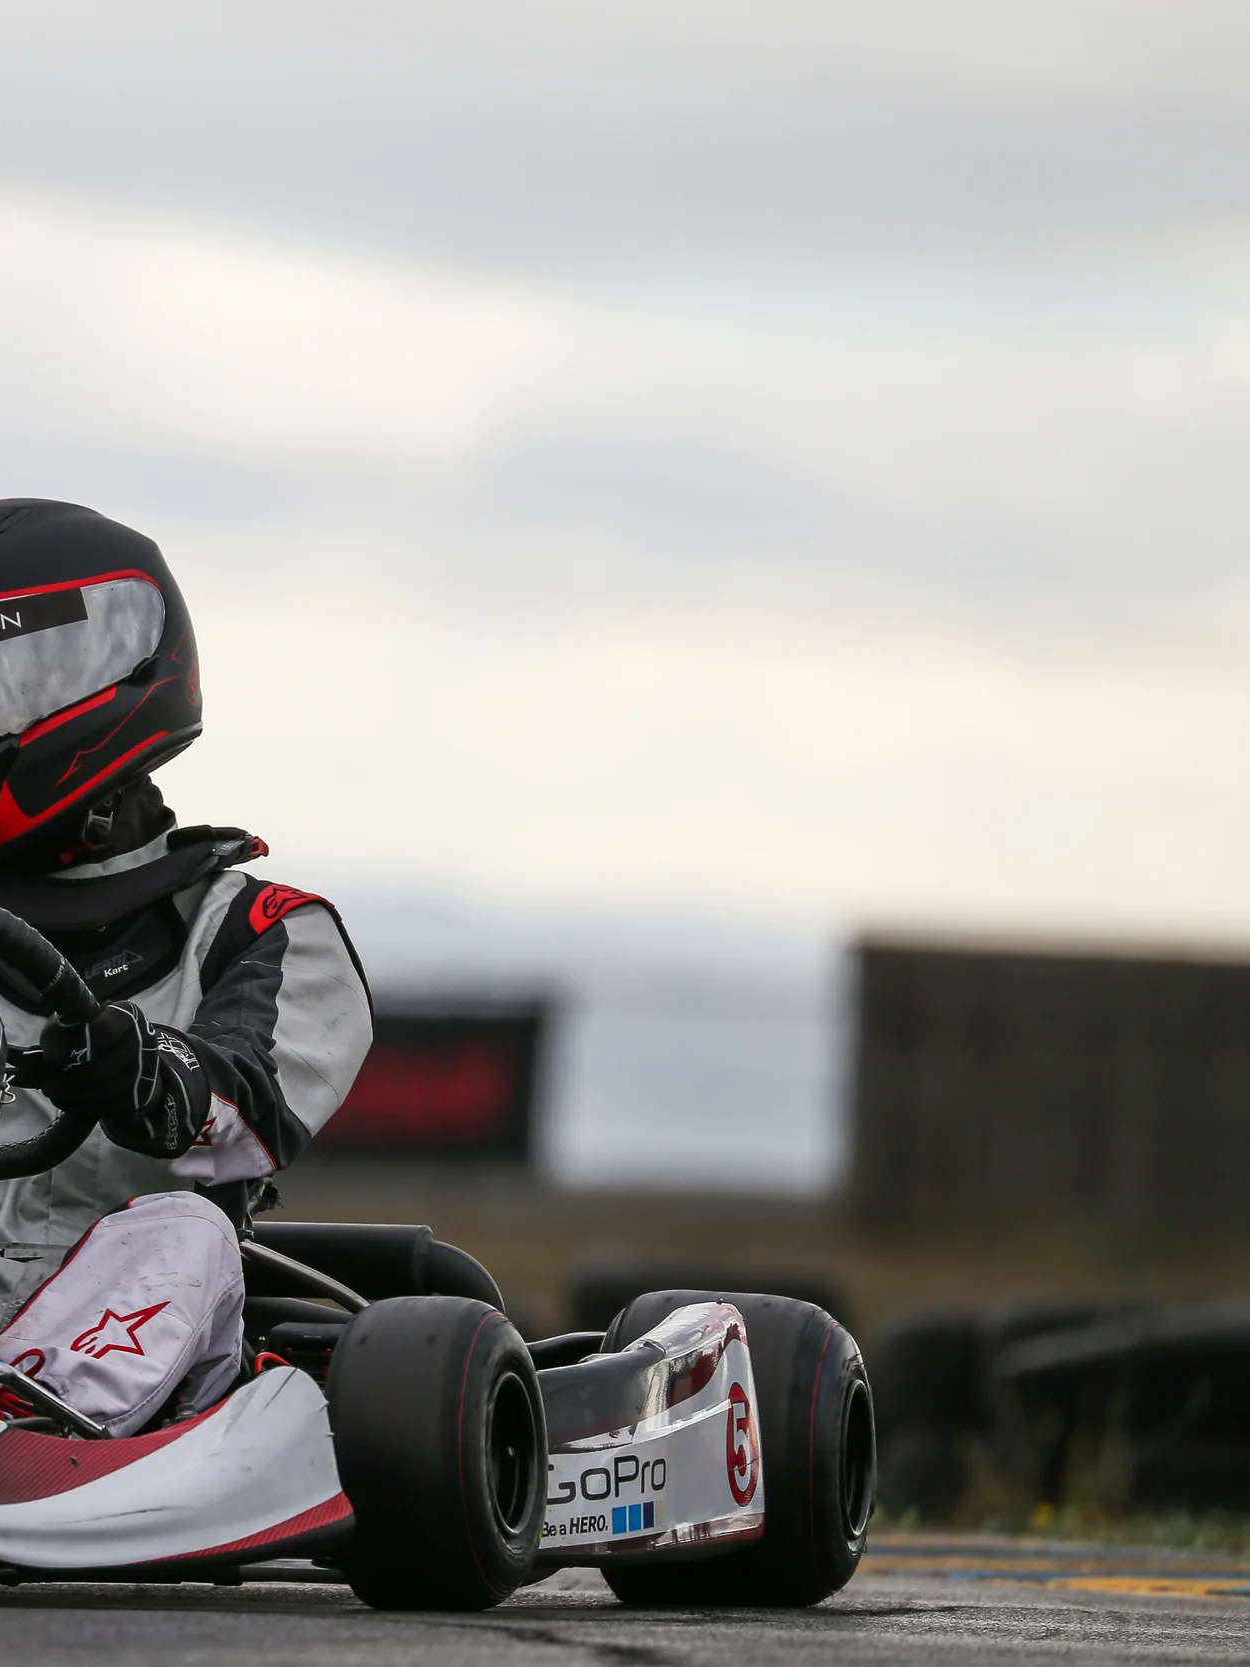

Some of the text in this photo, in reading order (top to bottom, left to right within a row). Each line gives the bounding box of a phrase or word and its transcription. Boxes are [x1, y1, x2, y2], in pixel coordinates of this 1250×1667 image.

[103, 963, 129, 978] Kart
[730, 1402, 751, 1501] 5
[546, 1455, 667, 1506] GoPro
[542, 1514, 609, 1538] Be a HERO.
